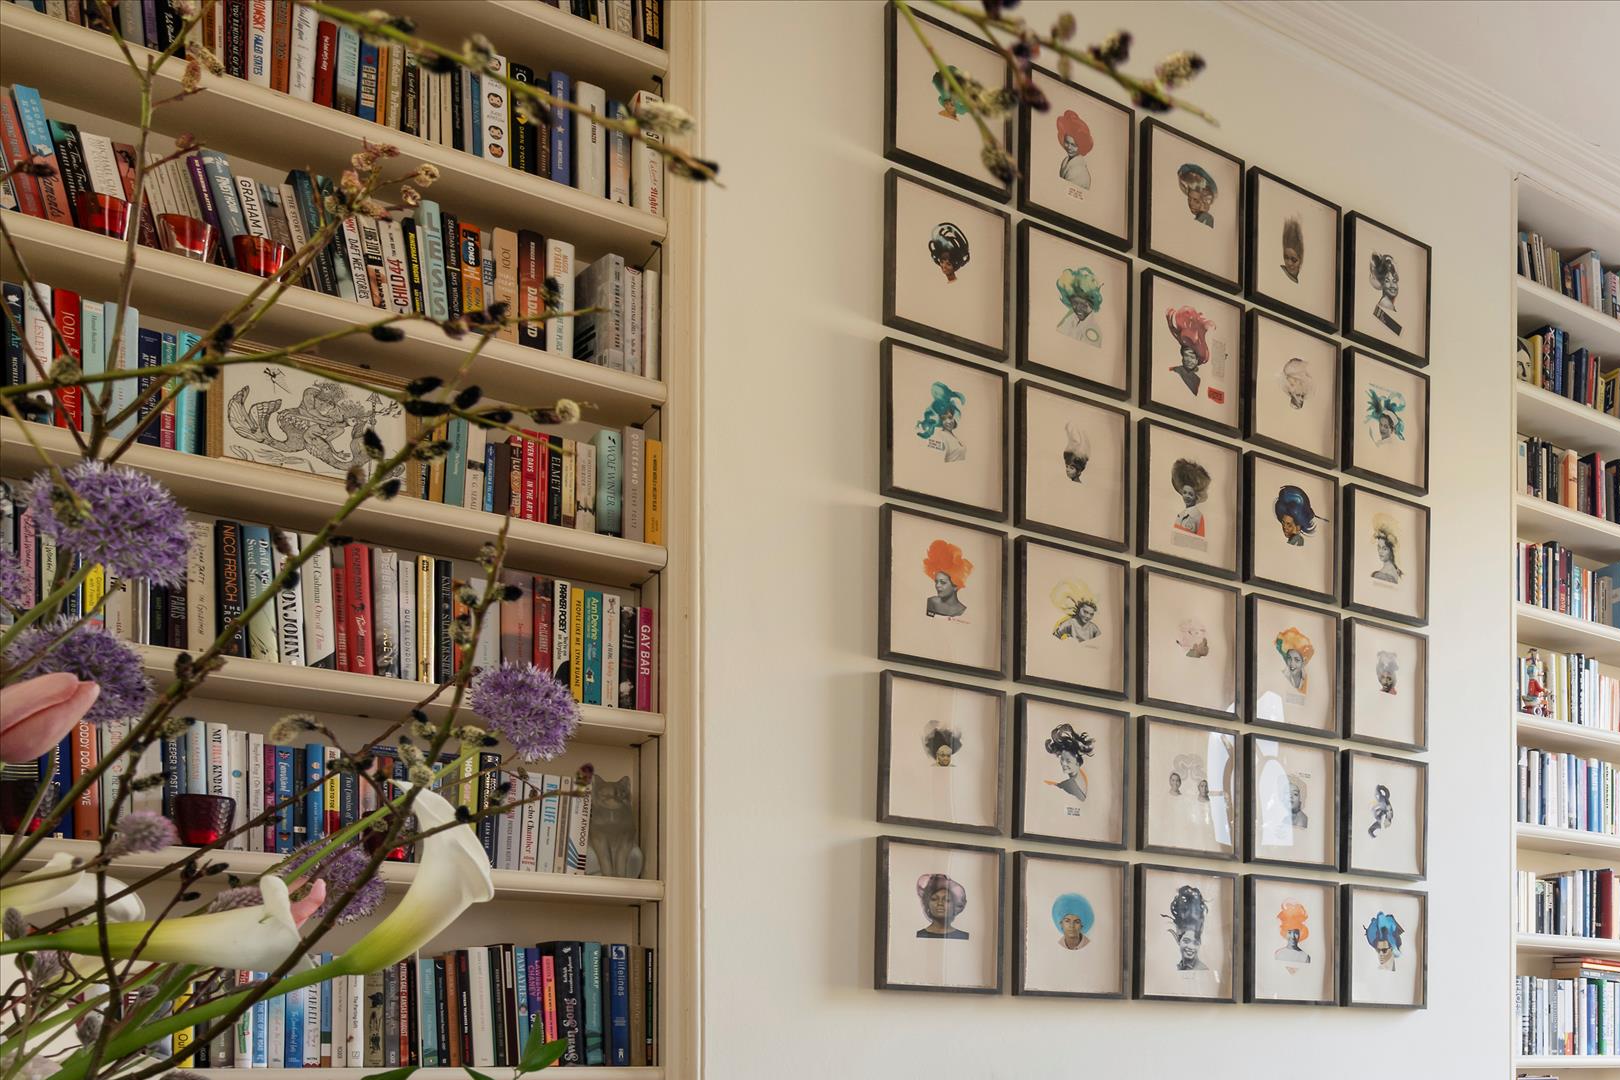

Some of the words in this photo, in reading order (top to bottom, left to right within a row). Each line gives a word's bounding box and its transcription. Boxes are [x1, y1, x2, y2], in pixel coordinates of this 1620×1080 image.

[232, 5, 240, 17] YOU
[232, 19, 240, 45] REMIND
[254, 34, 265, 54] FAILED
[232, 47, 240, 56] ME
[254, 55, 264, 76] STATES
[240, 180, 260, 229] GRAHAM
[286, 195, 295, 210] THE
[290, 212, 301, 233] STORY
[447, 220, 456, 248] SEBASTIAN
[348, 239, 360, 256] DAFT
[502, 248, 511, 269] JODI
[352, 257, 364, 271] WEE
[386, 259, 404, 275] 44
[483, 259, 493, 287] EILEEN
[354, 273, 369, 300] STORIES
[389, 274, 409, 307] CHILD
[450, 272, 458, 286] DAYS
[34, 318, 47, 353] LESLEY
[60, 310, 76, 339] JODI
[527, 441, 535, 457] EVEN
[606, 445, 616, 470] WOLF
[631, 433, 639, 486] QUICKSAND
[526, 457, 534, 473] DAYS
[551, 456, 561, 492] ELMET
[526, 489, 534, 500] THE
[606, 472, 616, 506] WINTER
[526, 501, 534, 513] ART
[223, 525, 236, 556] NICCI
[246, 538, 256, 565] Sweet
[259, 541, 269, 566] David
[223, 558, 238, 601] FRENCH
[248, 568, 258, 599] Sorrow
[381, 556, 391, 590] DEBBIE
[312, 569, 322, 604] Cashman
[559, 583, 568, 609] PARKER
[171, 595, 186, 620] PARIS
[590, 597, 599, 614] Ann
[558, 610, 567, 634] POSEY
[591, 614, 599, 640] Devine
[282, 613, 299, 658] JOHN
[575, 637, 582, 646] ME
[640, 624, 651, 648] GAY
[640, 650, 651, 675] BAR
[212, 729, 222, 744] NOT
[212, 764, 222, 784] KIND
[212, 785, 222, 795] OF
[544, 806, 556, 825] LIFE
[525, 820, 535, 853] Chamber
[579, 818, 588, 847] ATWOOD
[516, 952, 526, 972] PAM
[592, 950, 600, 989] WINDHARP
[518, 973, 527, 1004] AYRES
[528, 965, 536, 997] CHANEY
[617, 961, 626, 997] lifelines
[400, 996, 408, 1013] KANSAS
[562, 997, 578, 1028] Song
[564, 1027, 579, 1062] Swan
